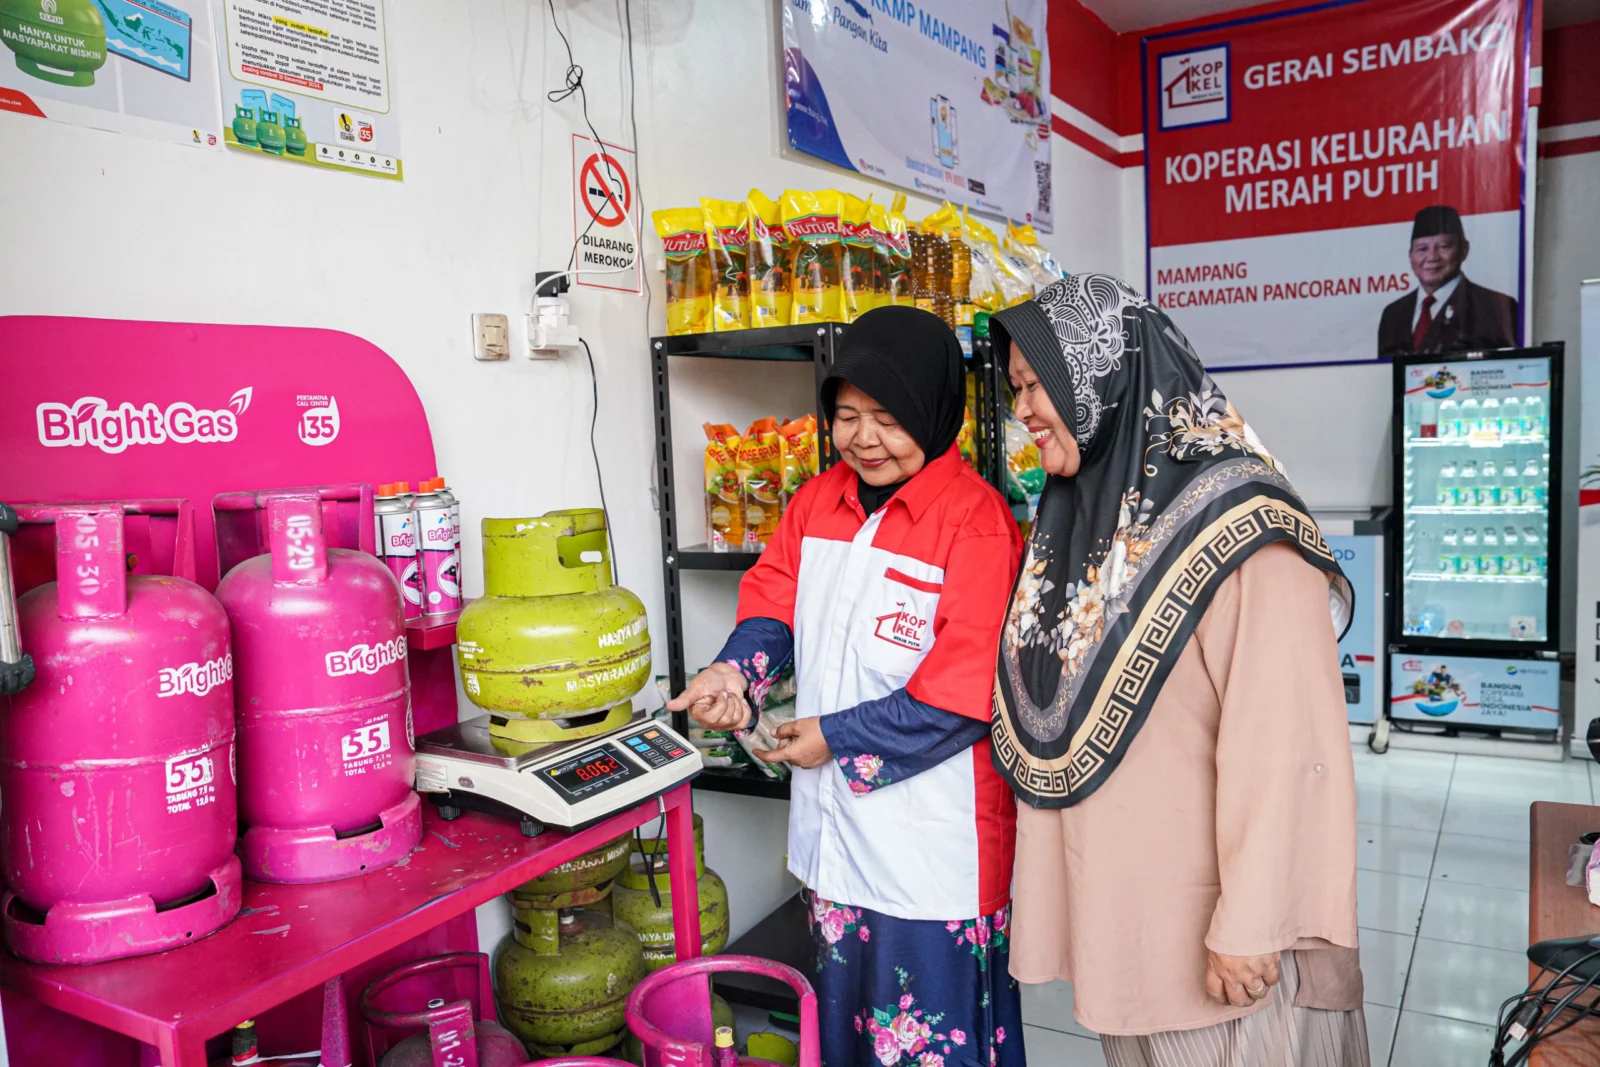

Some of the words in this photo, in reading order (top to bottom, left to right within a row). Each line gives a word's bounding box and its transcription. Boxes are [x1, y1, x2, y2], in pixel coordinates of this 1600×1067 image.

[238, 6, 255, 16] Usaha
[258, 13, 272, 21] Mikro
[19, 23, 53, 41] HANYA
[54, 33, 86, 49] UNTUK
[833, 6, 869, 42] Pangan
[869, 28, 889, 54] Kita
[919, 8, 987, 70] MAMPANG
[2, 28, 69, 54] MASYARAKAT
[70, 47, 102, 60] MISKIN
[241, 44, 258, 53] Usaha
[241, 50, 268, 62] Pertamina
[1243, 53, 1334, 91] GERAI
[1342, 21, 1508, 75] SEMBAKO
[1191, 60, 1224, 78] KOP
[1191, 76, 1222, 92] KEL
[1164, 139, 1301, 185] KOPERASI
[1310, 109, 1508, 167] KELURAHAN
[1225, 174, 1334, 214] MERAH
[1343, 160, 1440, 201] PUTIH
[787, 220, 840, 238] NUTUR
[582, 234, 634, 254] DILARANG
[584, 251, 634, 270] MEROKOK
[1157, 261, 1248, 286] MAMPANG
[1157, 284, 1259, 310] KECAMATAN
[1262, 276, 1363, 302] PANCORAN
[1366, 272, 1411, 294] MAS
[39, 397, 164, 451] Bright
[167, 408, 237, 442] Gas
[901, 611, 927, 629] KOP
[896, 624, 921, 641] KEL
[326, 641, 397, 677] Bright
[157, 661, 225, 697] Bright
[566, 658, 640, 693] MASYARAKAT
[1480, 682, 1522, 690] BANGUN
[1480, 703, 1532, 711] INDONESIA
[344, 758, 374, 770] TABUNG
[344, 768, 366, 777] TOTAL
[575, 755, 620, 781] 8.062
[166, 789, 198, 804] TABUNG
[166, 801, 192, 815] TOTAL
